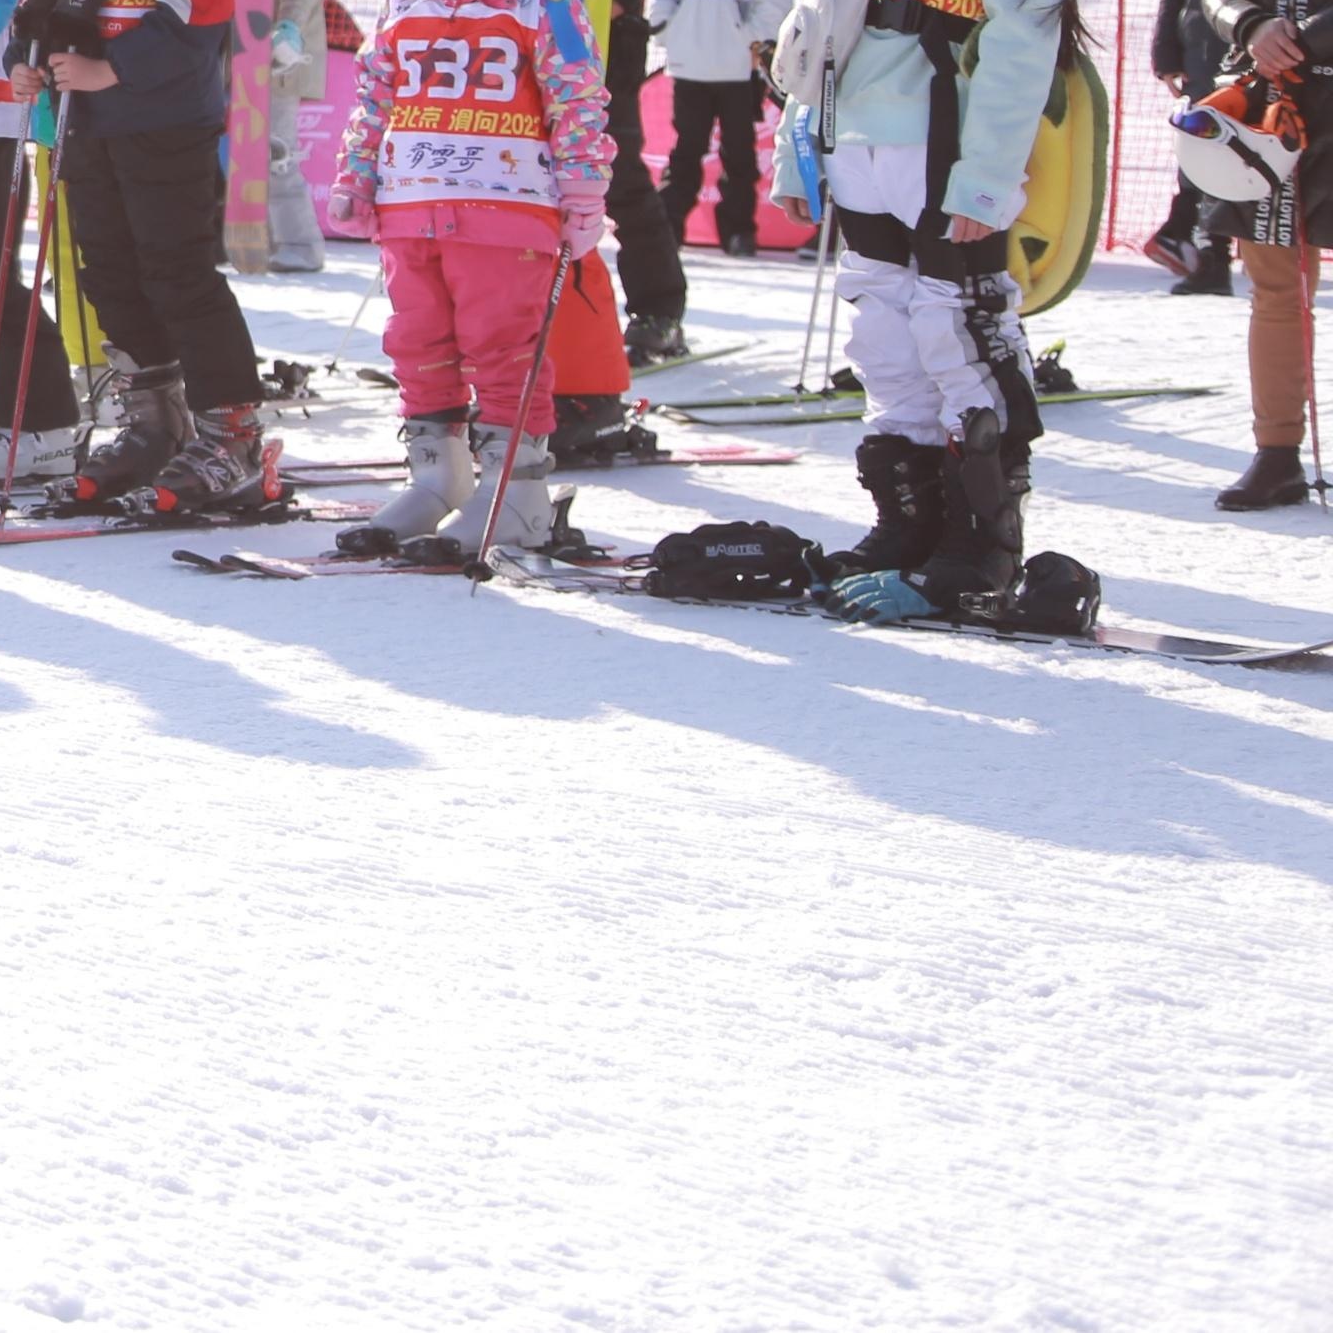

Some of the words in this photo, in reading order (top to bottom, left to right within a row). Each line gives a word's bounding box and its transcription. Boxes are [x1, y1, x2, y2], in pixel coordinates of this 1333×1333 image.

[395, 36, 519, 101] 533
[1279, 198, 1293, 225] LOVE
[1254, 218, 1268, 245] LOVE
